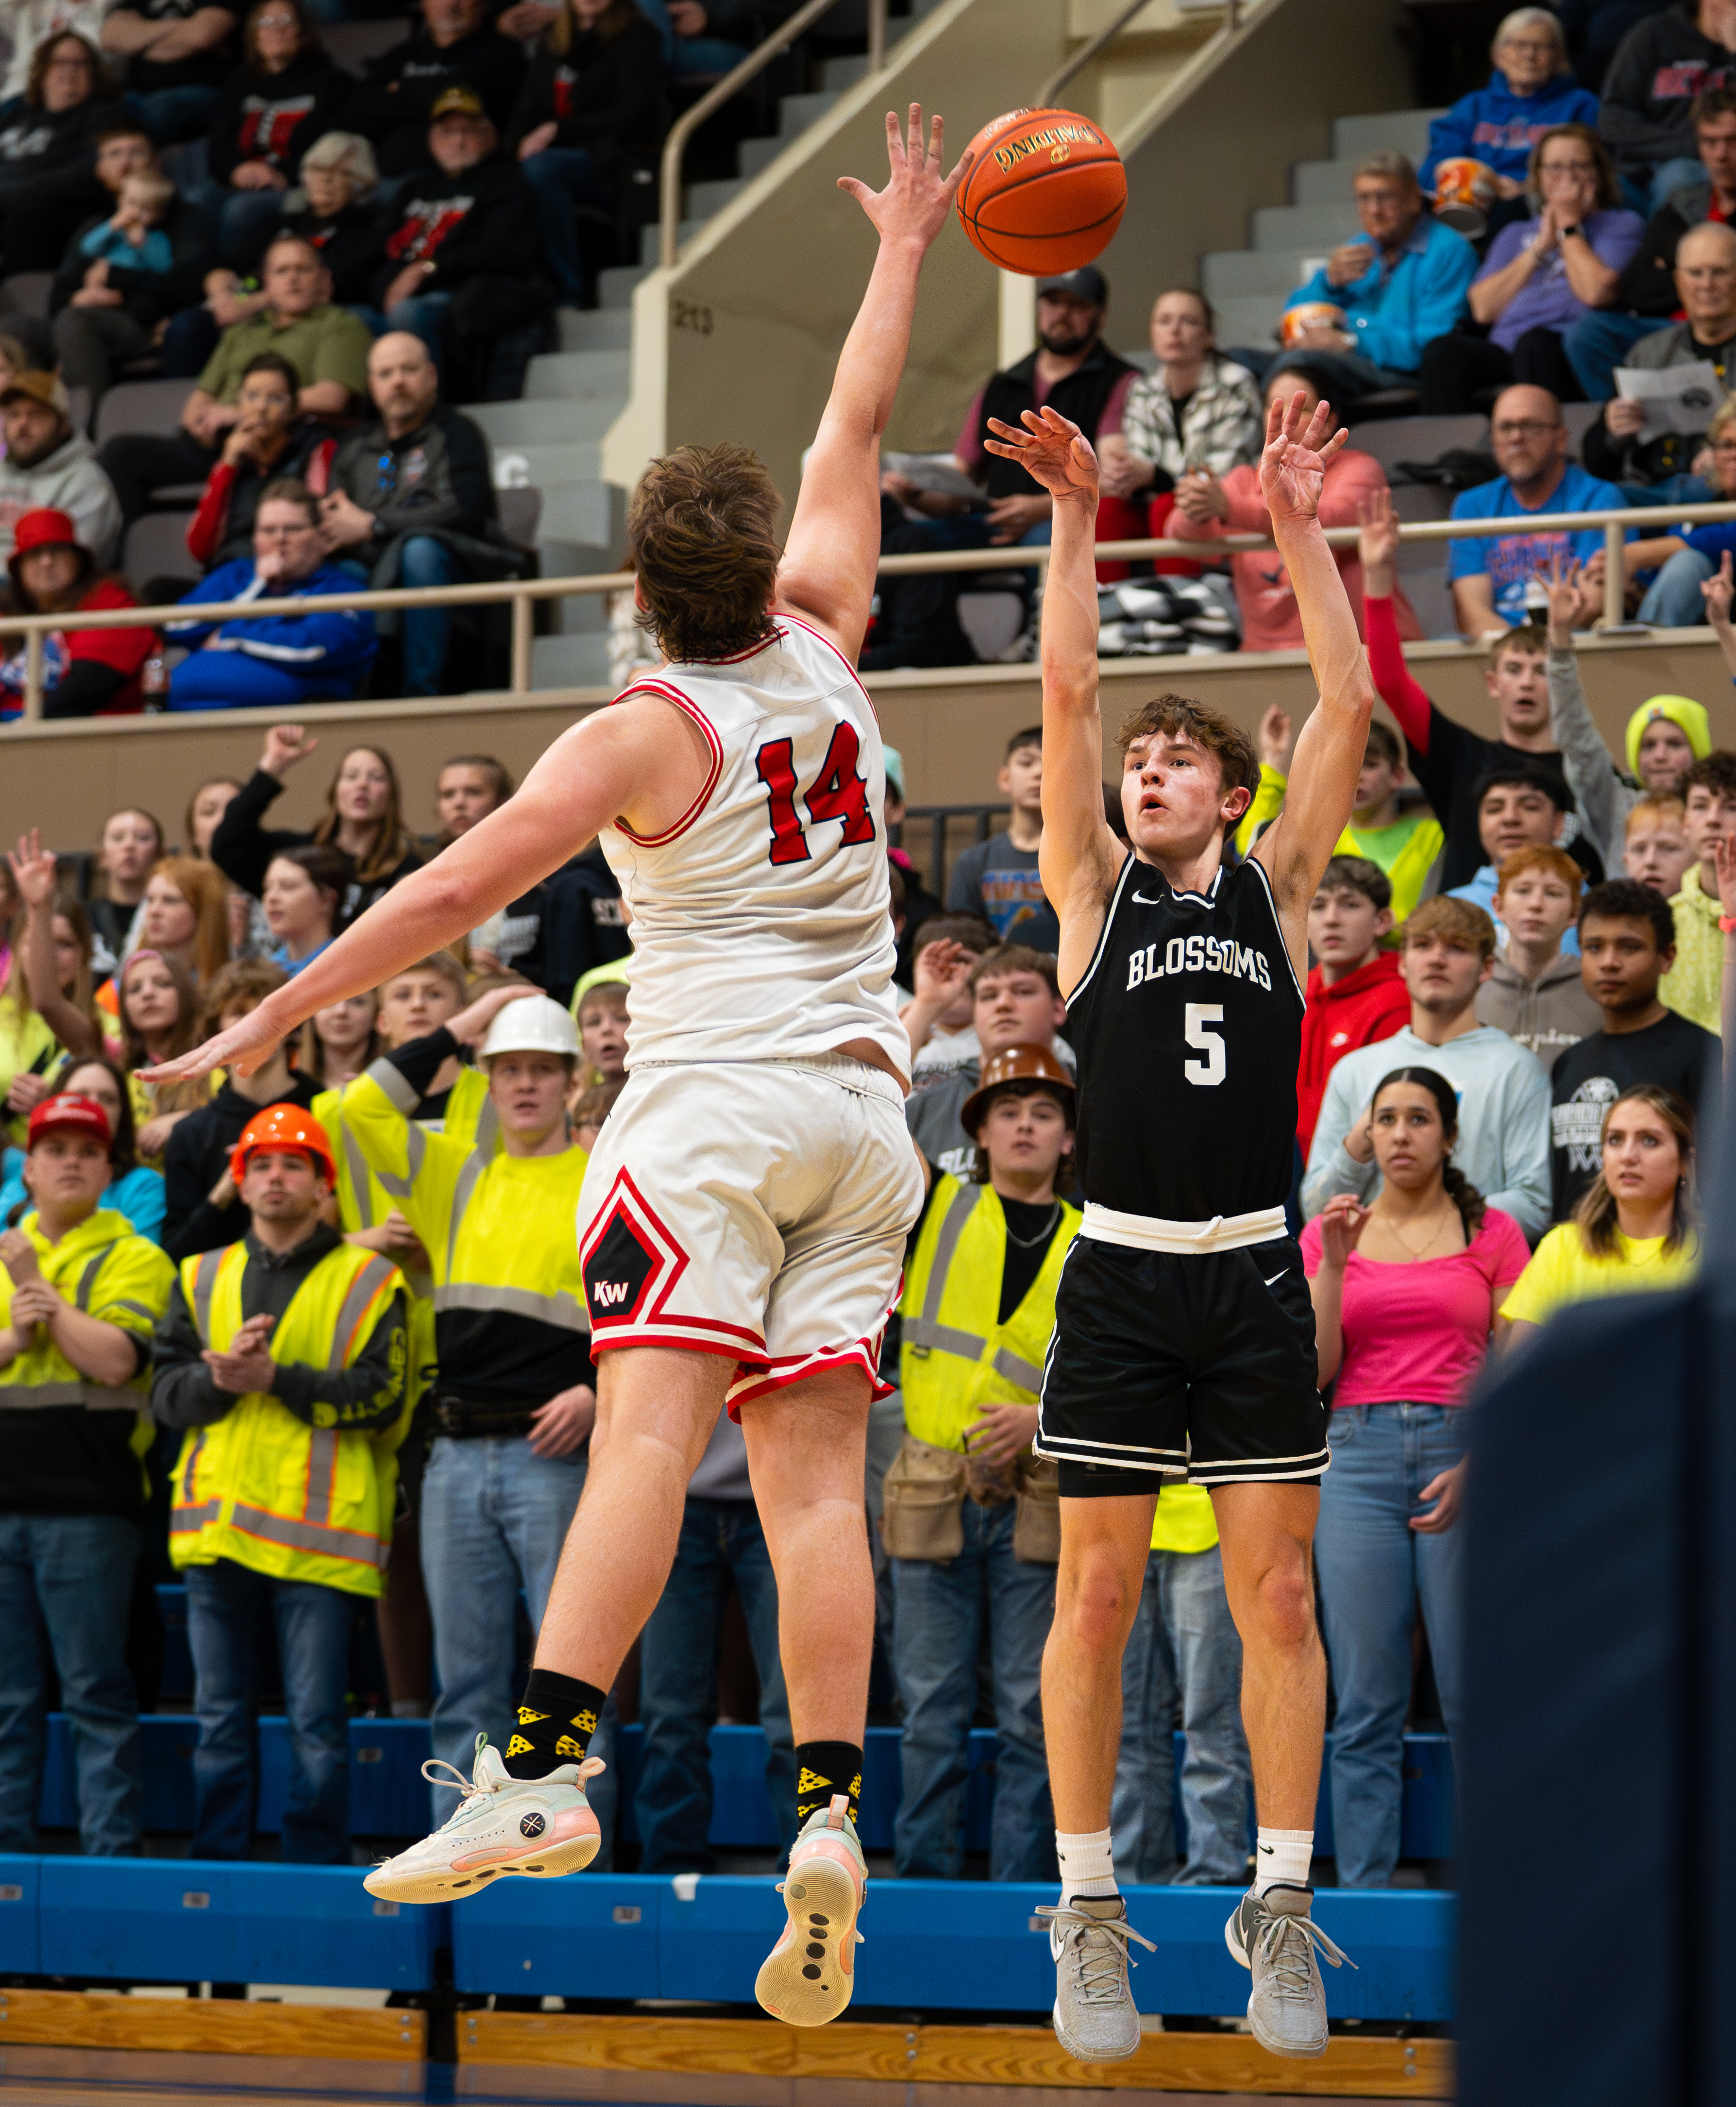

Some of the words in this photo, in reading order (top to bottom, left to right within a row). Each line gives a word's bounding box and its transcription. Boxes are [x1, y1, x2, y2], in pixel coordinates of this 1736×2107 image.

[674, 300, 714, 336] 213
[755, 720, 876, 867] 14
[1127, 935, 1272, 991] BLOSSOMS
[1185, 1003, 1226, 1086] 5
[594, 1280, 629, 1307] KW
